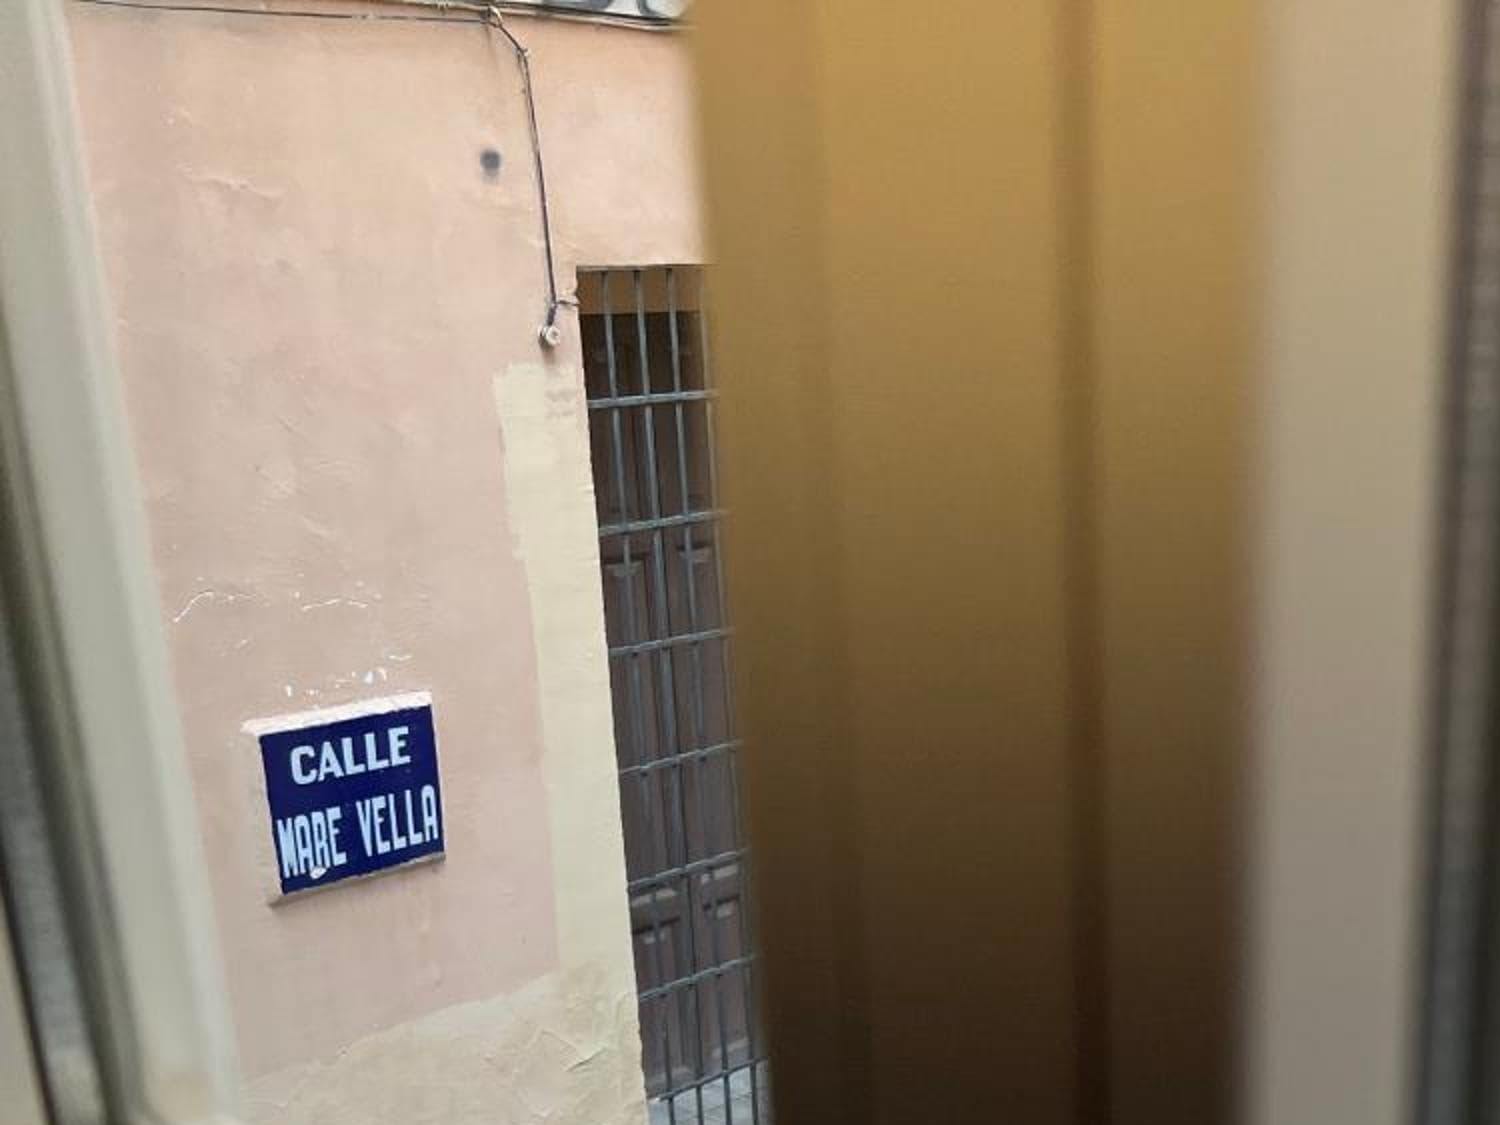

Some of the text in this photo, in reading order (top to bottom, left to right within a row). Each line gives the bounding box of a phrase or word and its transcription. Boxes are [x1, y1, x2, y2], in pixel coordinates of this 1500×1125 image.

[290, 726, 411, 785] CALLE
[277, 784, 439, 879] MARE VELLA
